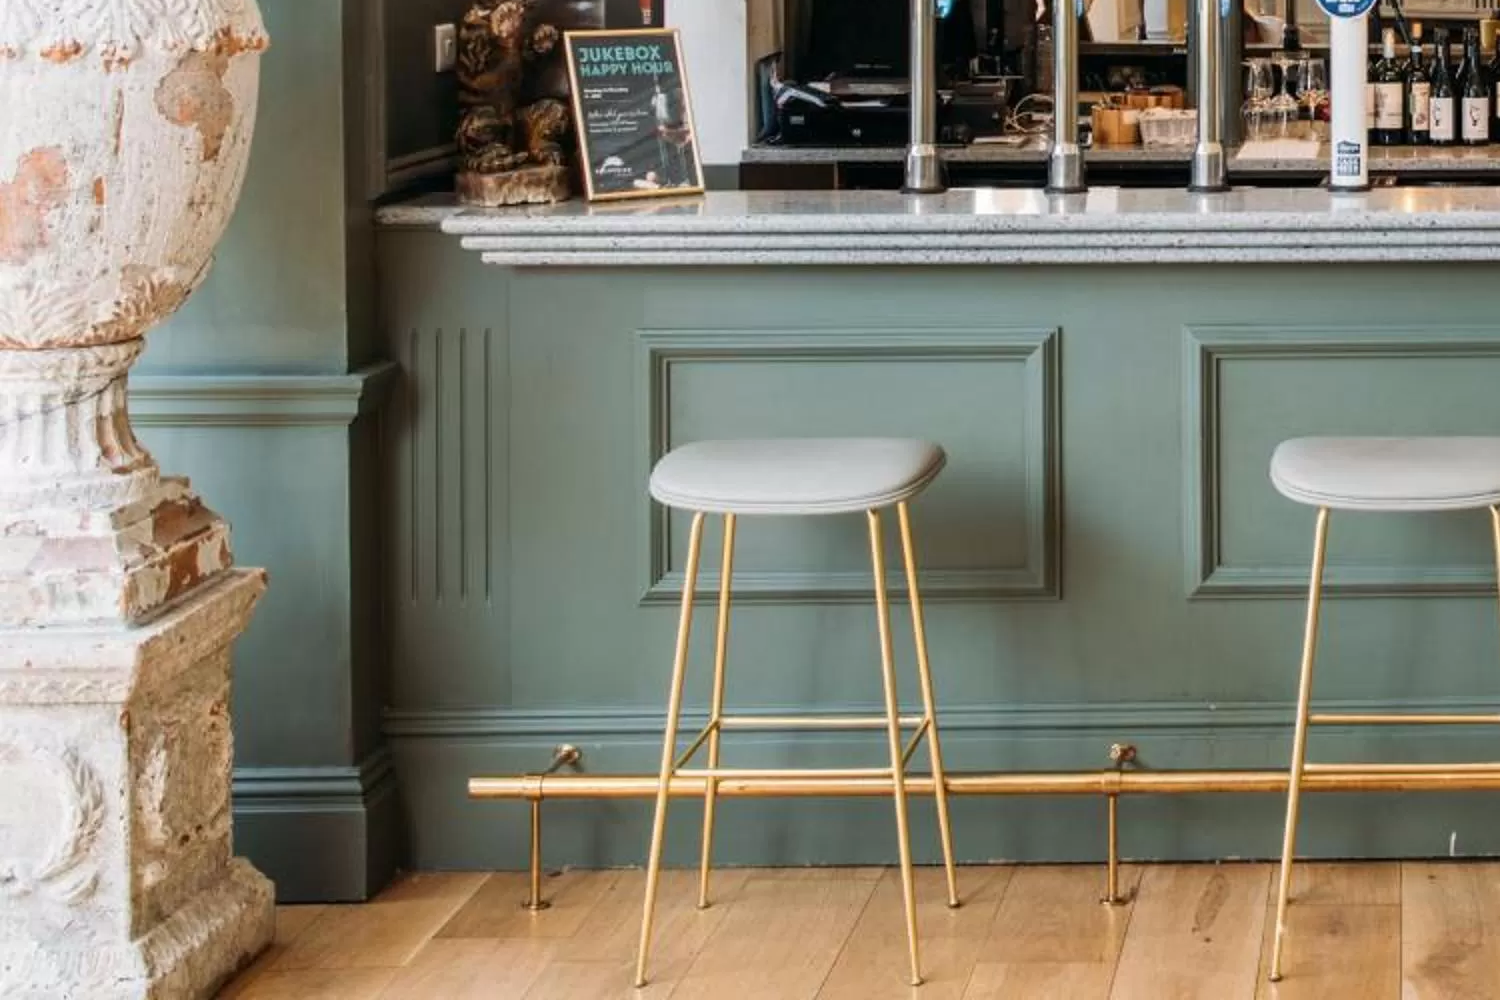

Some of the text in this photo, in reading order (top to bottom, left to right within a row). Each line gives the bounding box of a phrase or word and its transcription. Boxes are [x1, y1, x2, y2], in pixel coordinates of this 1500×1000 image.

[578, 45, 661, 62] JUKEBOX
[580, 60, 674, 77] HAPPY HOUR
